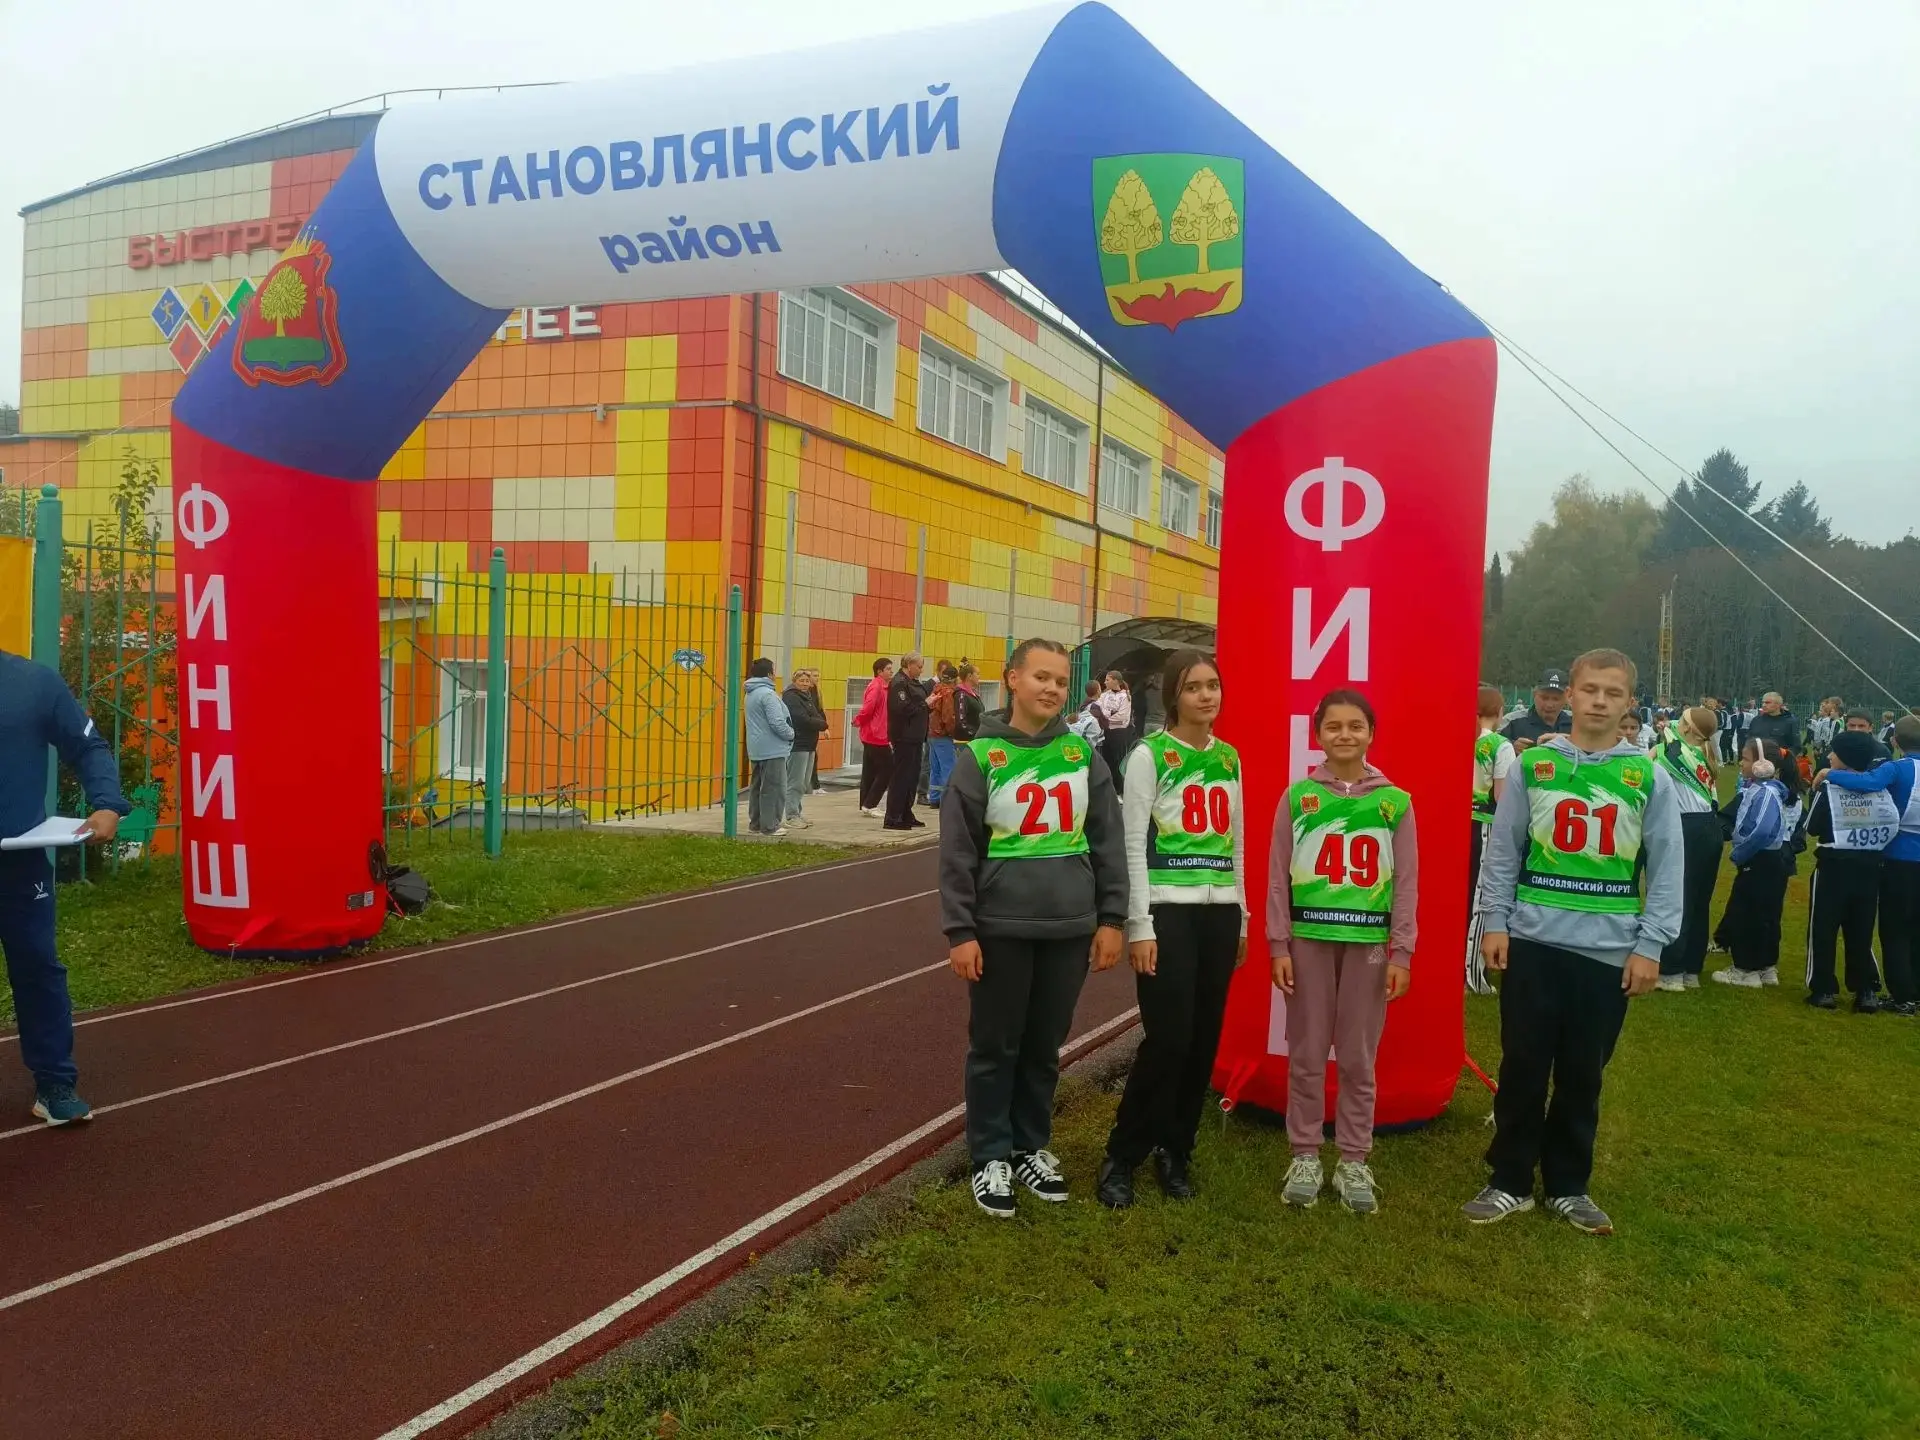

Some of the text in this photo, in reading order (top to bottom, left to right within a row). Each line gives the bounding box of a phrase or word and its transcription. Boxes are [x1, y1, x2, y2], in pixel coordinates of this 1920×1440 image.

[418, 82, 960, 211] СТАНОВЛЯНСКИЙ
[599, 215, 782, 273] район
[178, 483, 249, 909] ФИНИШ
[1016, 781, 1074, 836] 21
[1182, 784, 1230, 836] 80
[1552, 798, 1618, 856] 61
[1840, 799, 1873, 808] НАЦИИ
[1315, 833, 1380, 888] 49
[1846, 826, 1890, 847] 4933
[1531, 875, 1631, 894] СТАНОВЛЯНСКИЙ ОКРУГ
[1303, 910, 1366, 923] СТАНОВЛЯНСКИЙ
